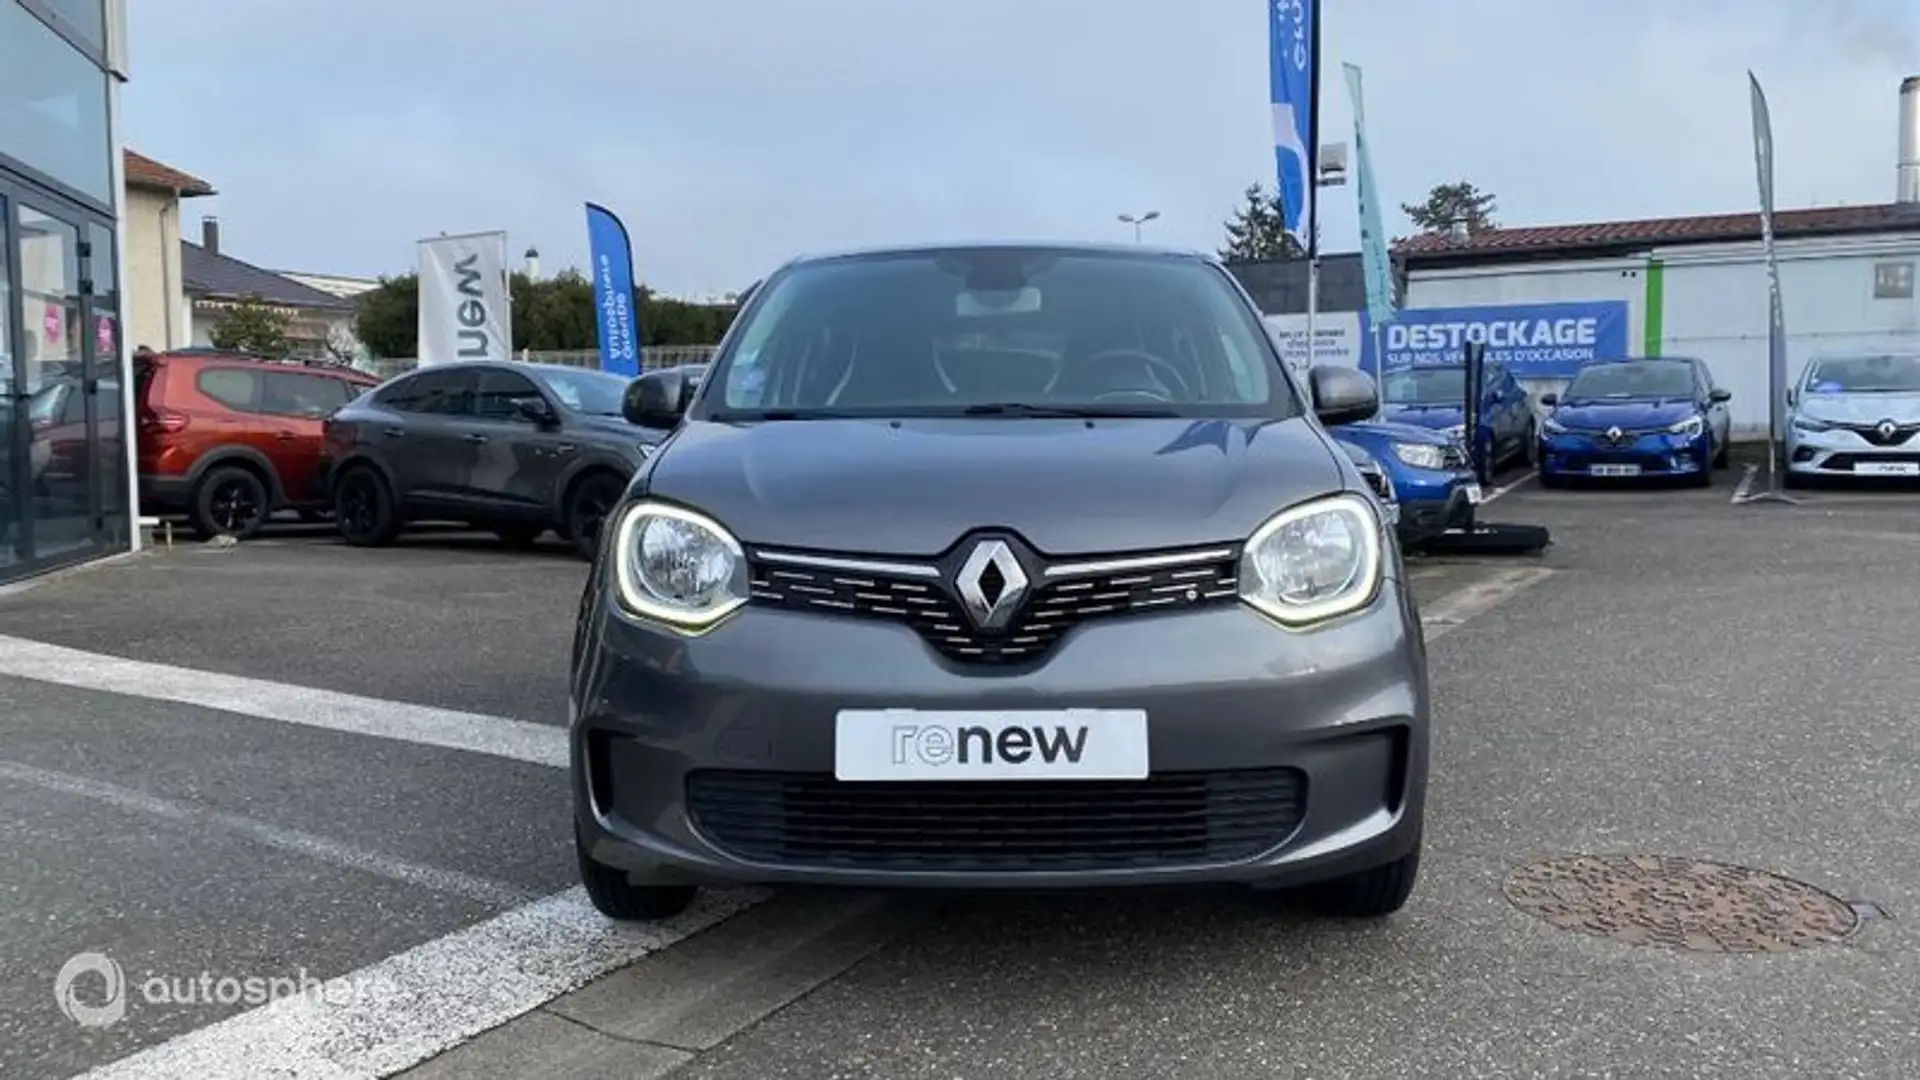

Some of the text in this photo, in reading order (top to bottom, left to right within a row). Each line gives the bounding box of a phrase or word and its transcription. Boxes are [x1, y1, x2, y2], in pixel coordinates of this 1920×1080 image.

[1387, 317, 1597, 350] DESTOCKAGE
[1514, 347, 1594, 361] D'OCCASION
[891, 724, 1088, 766] renew
